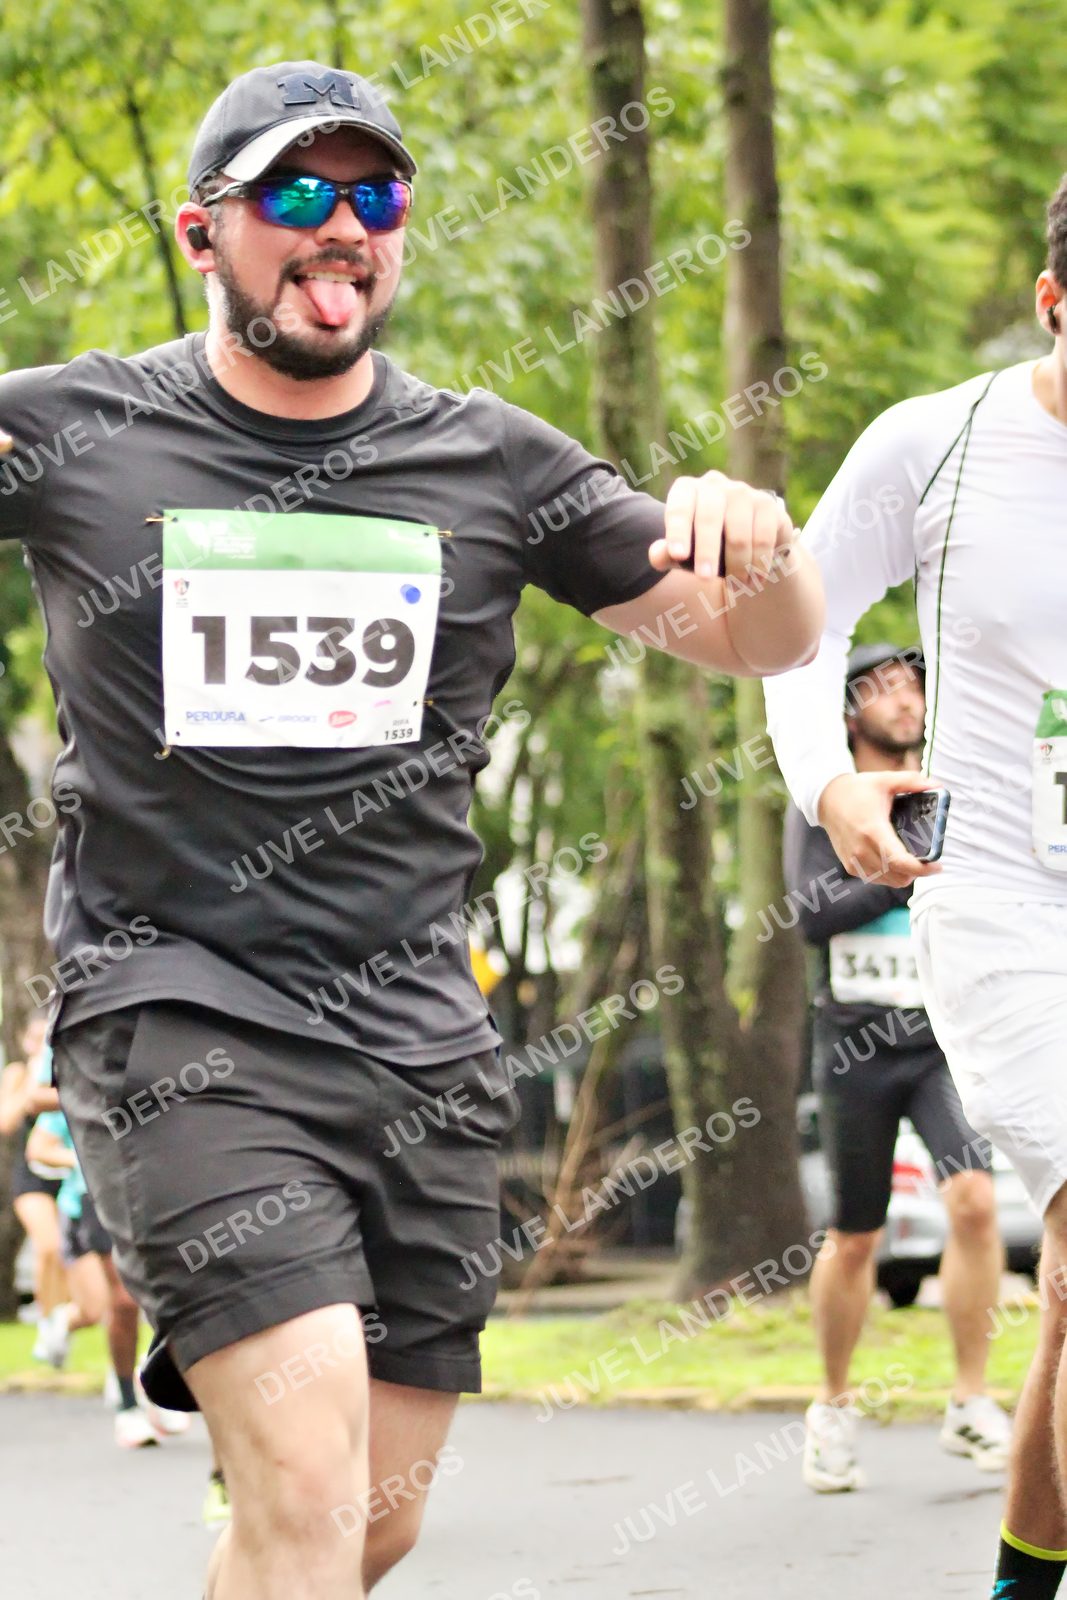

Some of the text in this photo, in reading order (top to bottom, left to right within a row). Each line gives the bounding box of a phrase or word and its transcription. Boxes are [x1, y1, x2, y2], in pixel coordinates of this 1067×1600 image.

[277, 71, 361, 110] M
[192, 616, 415, 688] 1539
[384, 728, 413, 740] 1539
